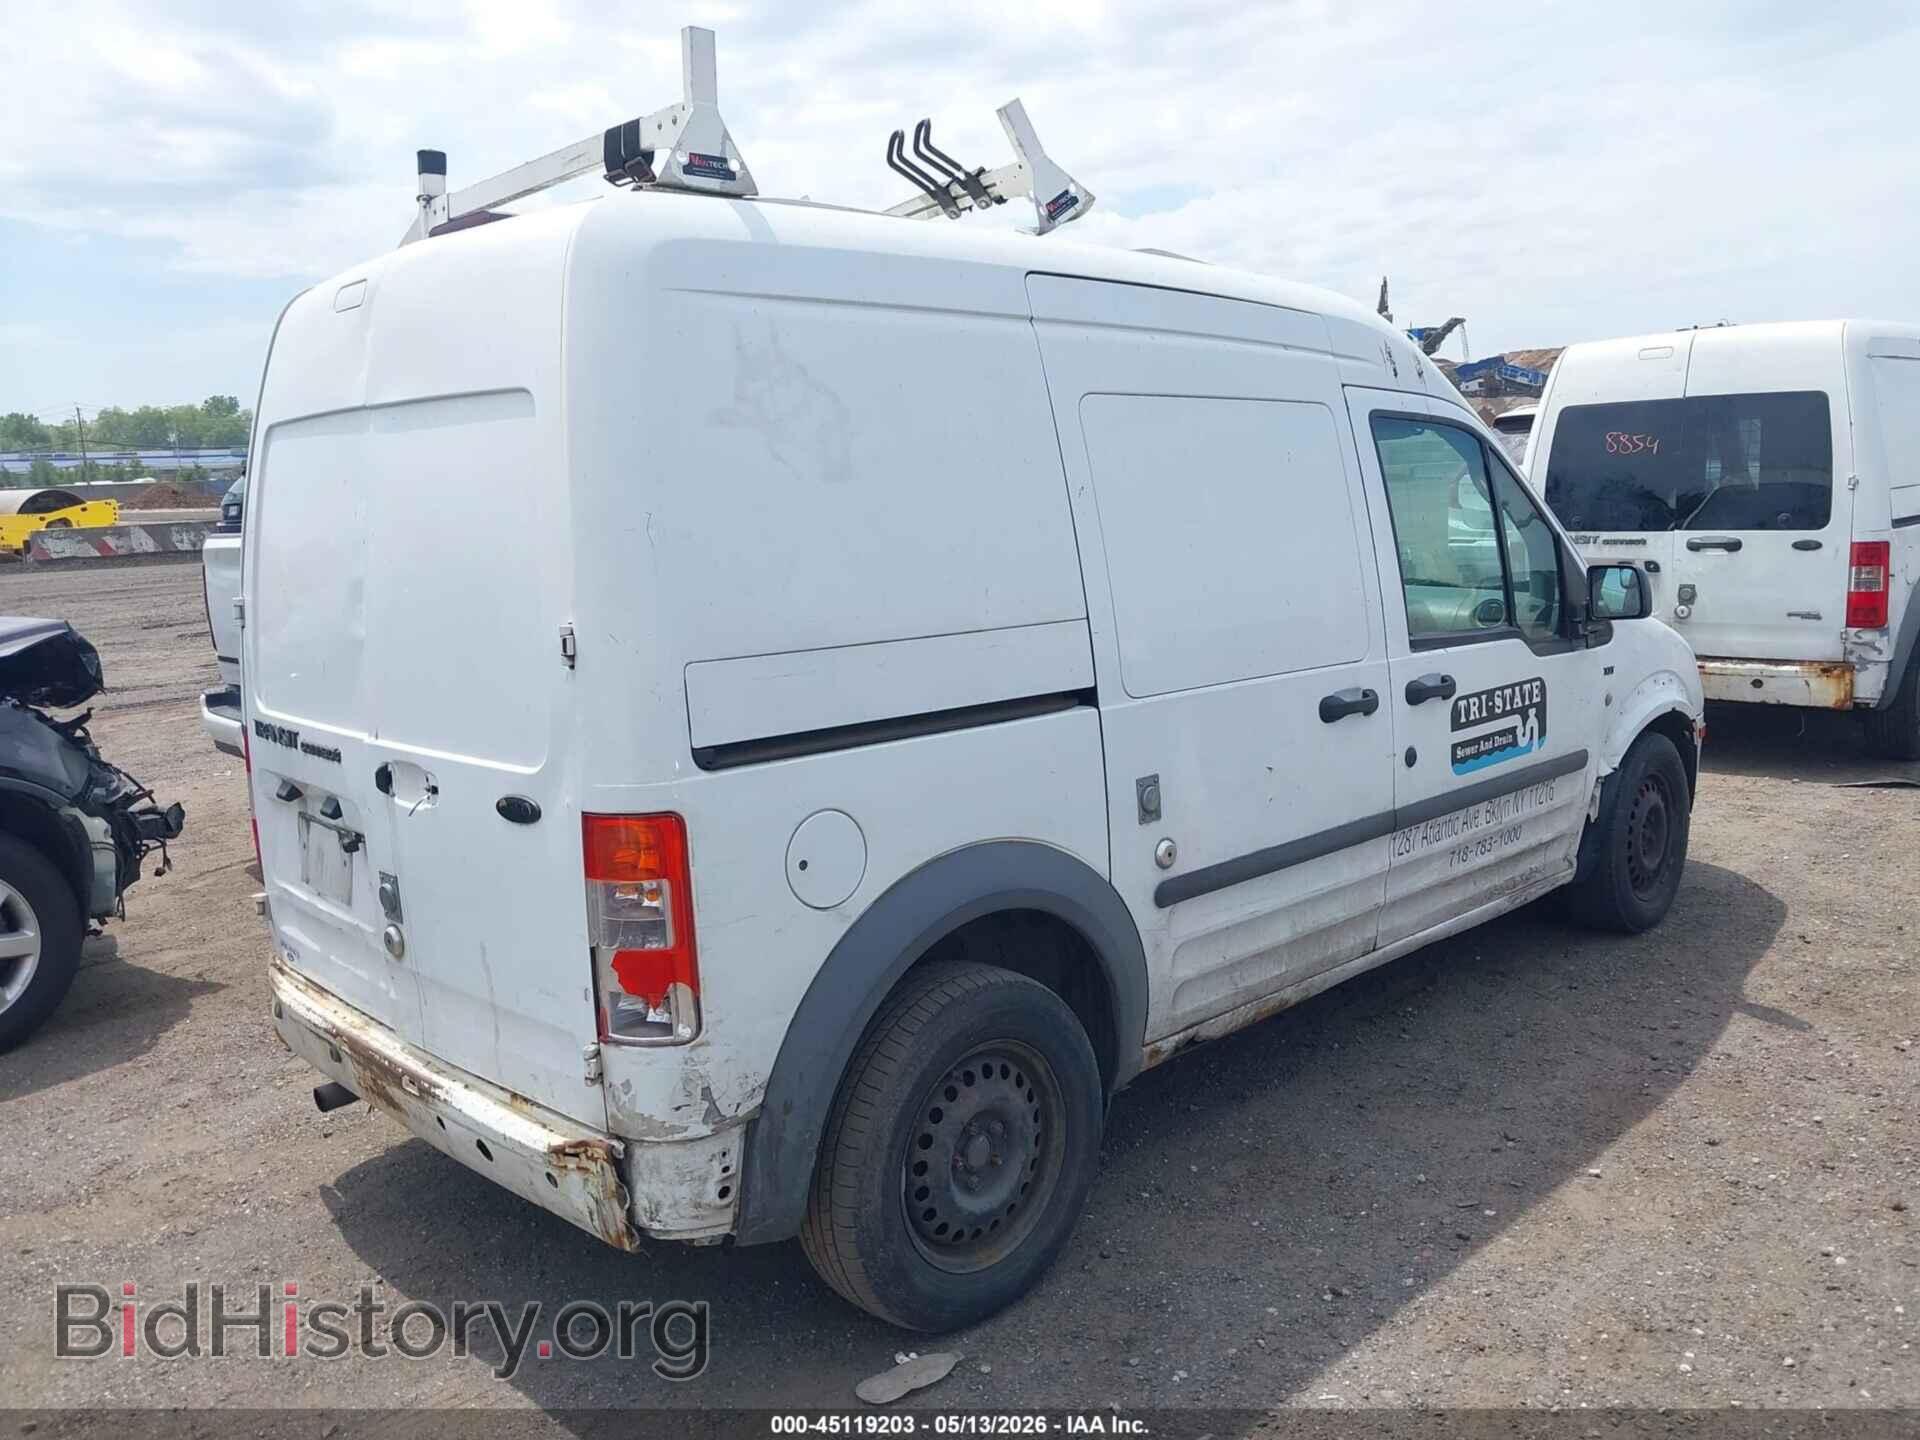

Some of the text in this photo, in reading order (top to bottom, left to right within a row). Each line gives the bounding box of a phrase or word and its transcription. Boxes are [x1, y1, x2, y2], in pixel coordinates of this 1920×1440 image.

[1606, 431, 1660, 455] 8854
[1457, 680, 1542, 723] TRI-STATE
[1456, 732, 1513, 759] Sewer And Drain
[1391, 825, 1420, 859] 1287
[1420, 814, 1460, 849] Atlantic
[1461, 806, 1483, 833] Ave.
[1450, 823, 1522, 867] 718-783-1000
